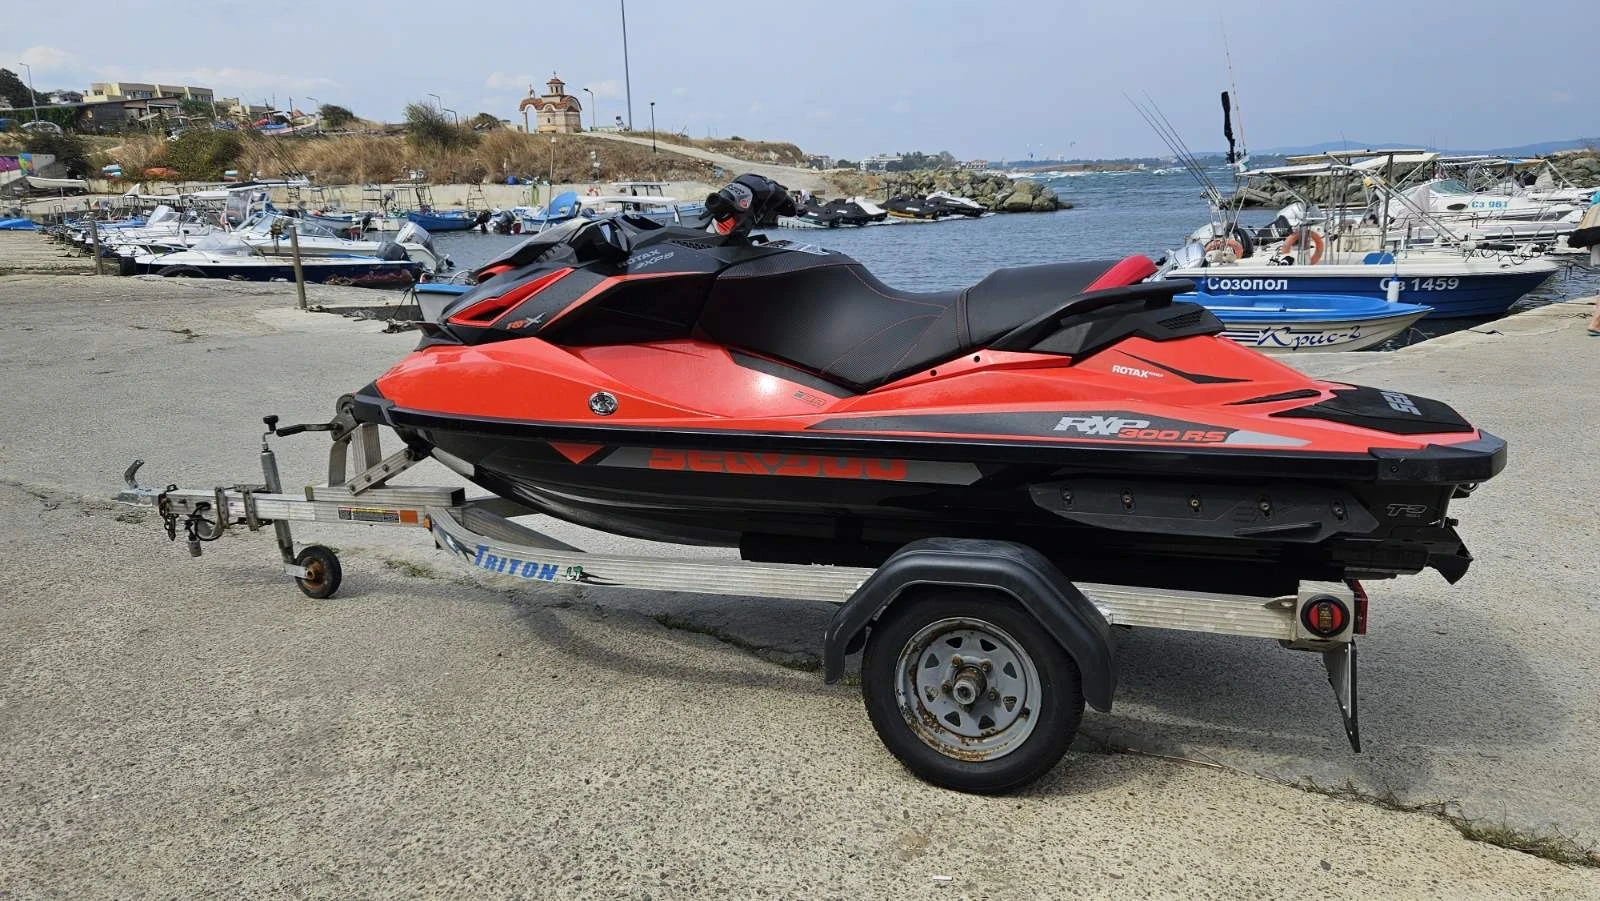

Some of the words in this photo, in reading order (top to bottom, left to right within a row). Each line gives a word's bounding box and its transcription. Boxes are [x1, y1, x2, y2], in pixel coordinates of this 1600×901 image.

[1207, 277, 1288, 291] Созопол
[1411, 277, 1460, 291] 1459
[1257, 326, 1361, 351] Крис-2
[1112, 365, 1149, 379] ROTAX
[1053, 415, 1150, 436] RXP
[1117, 428, 1177, 440] 300
[1181, 430, 1228, 442] RS
[474, 544, 560, 581] TRITON
